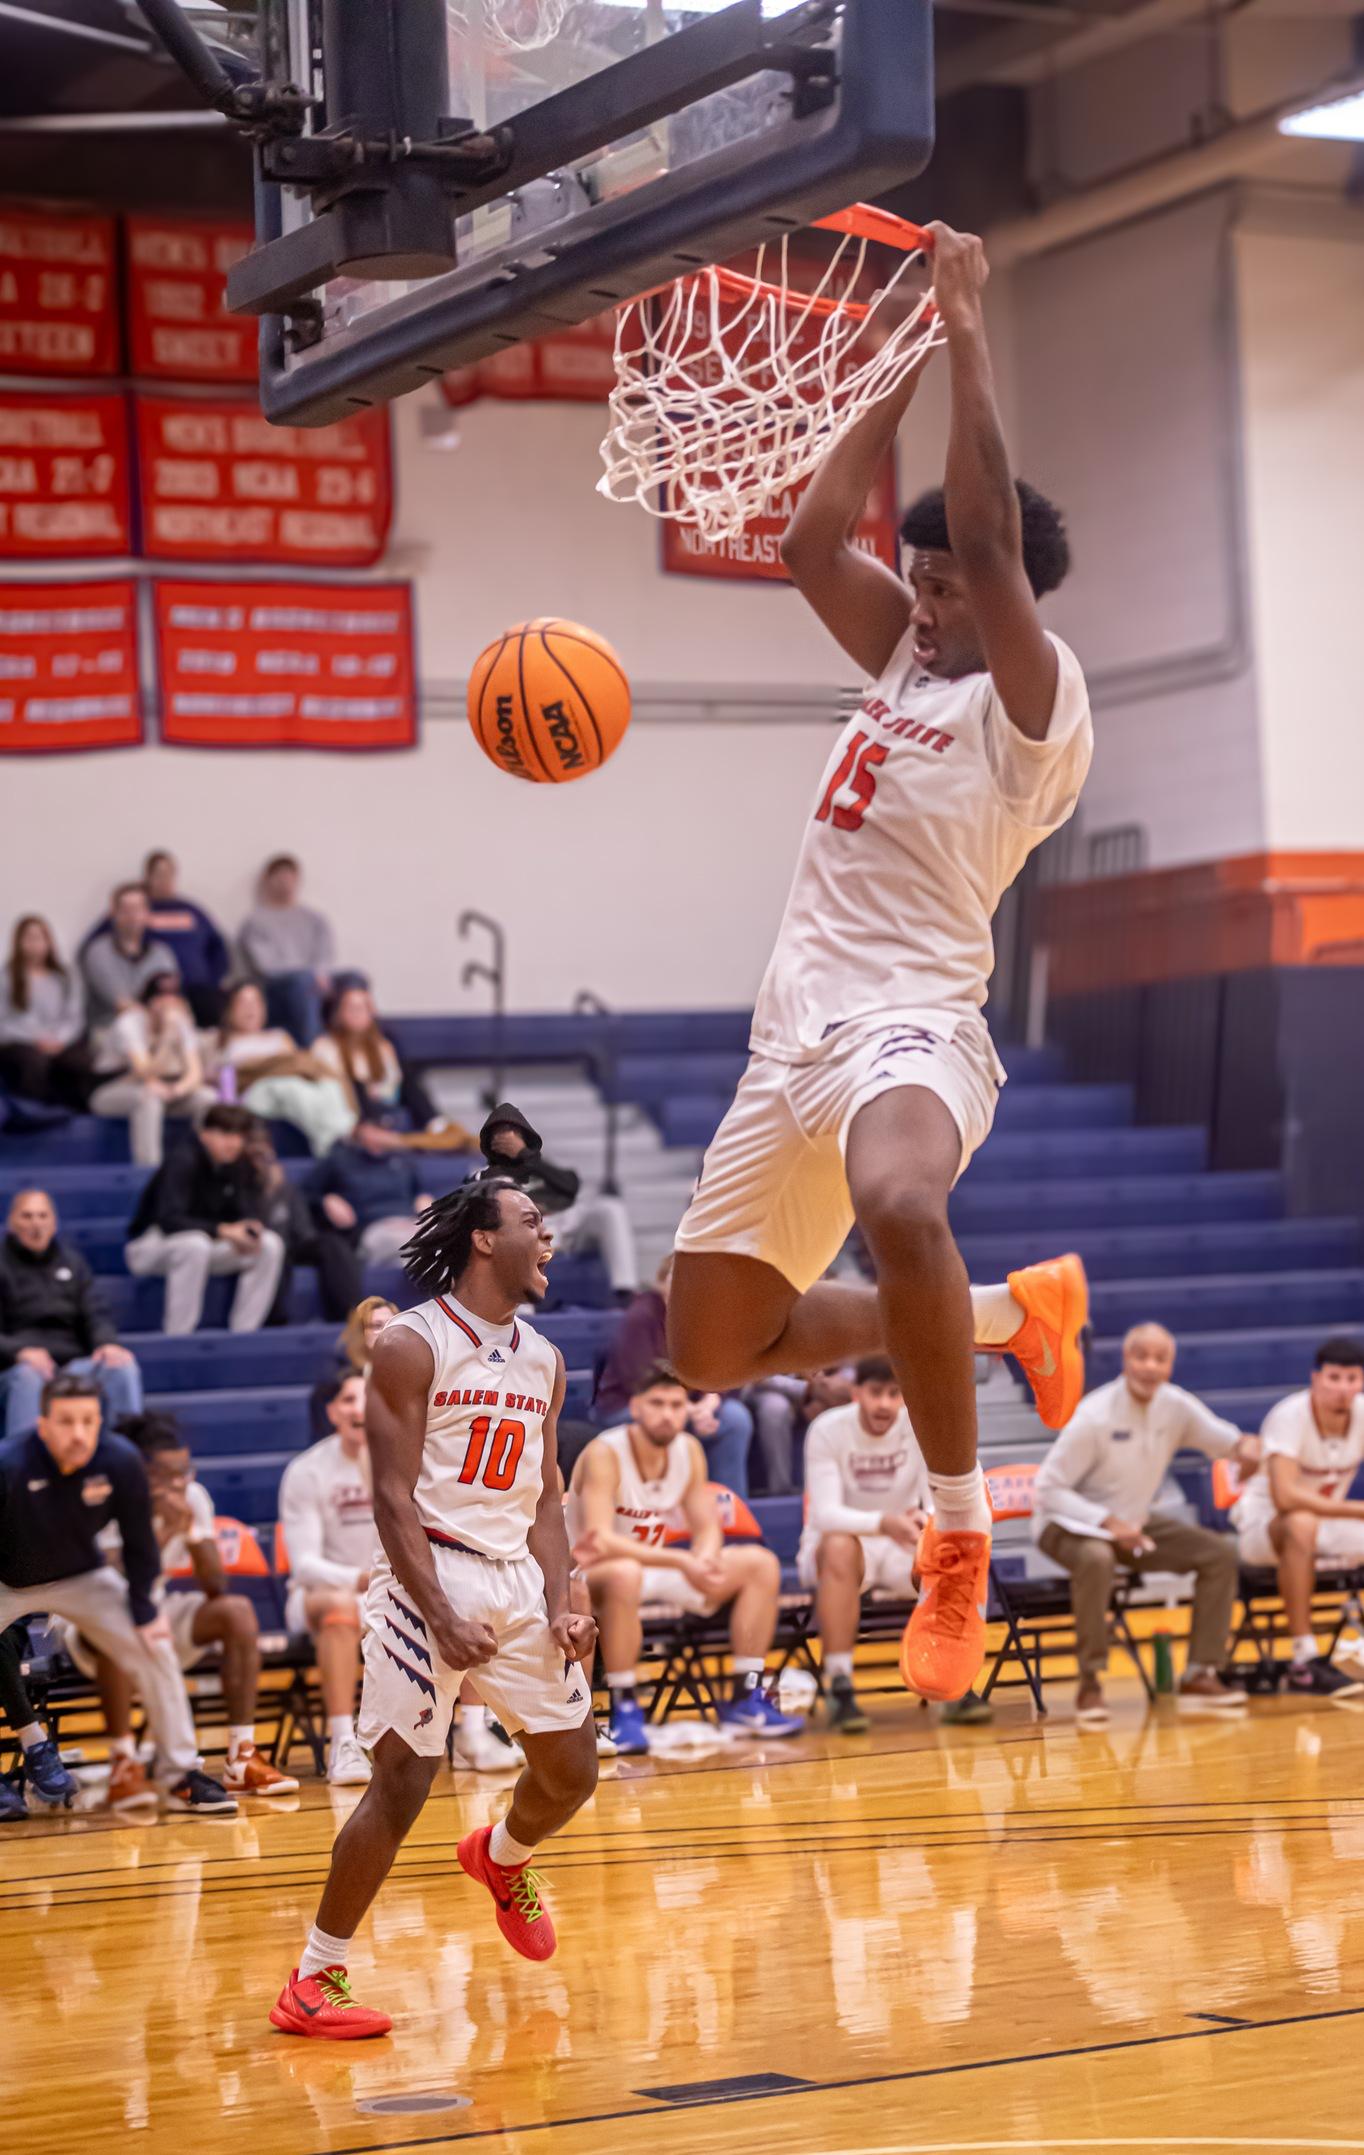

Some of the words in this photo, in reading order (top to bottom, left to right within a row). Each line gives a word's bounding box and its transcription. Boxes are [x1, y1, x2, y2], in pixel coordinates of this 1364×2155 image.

[542, 701, 585, 770] NCAA
[814, 730, 891, 832] 15
[433, 1389, 499, 1407] SALEM
[457, 1415, 526, 1491] 10
